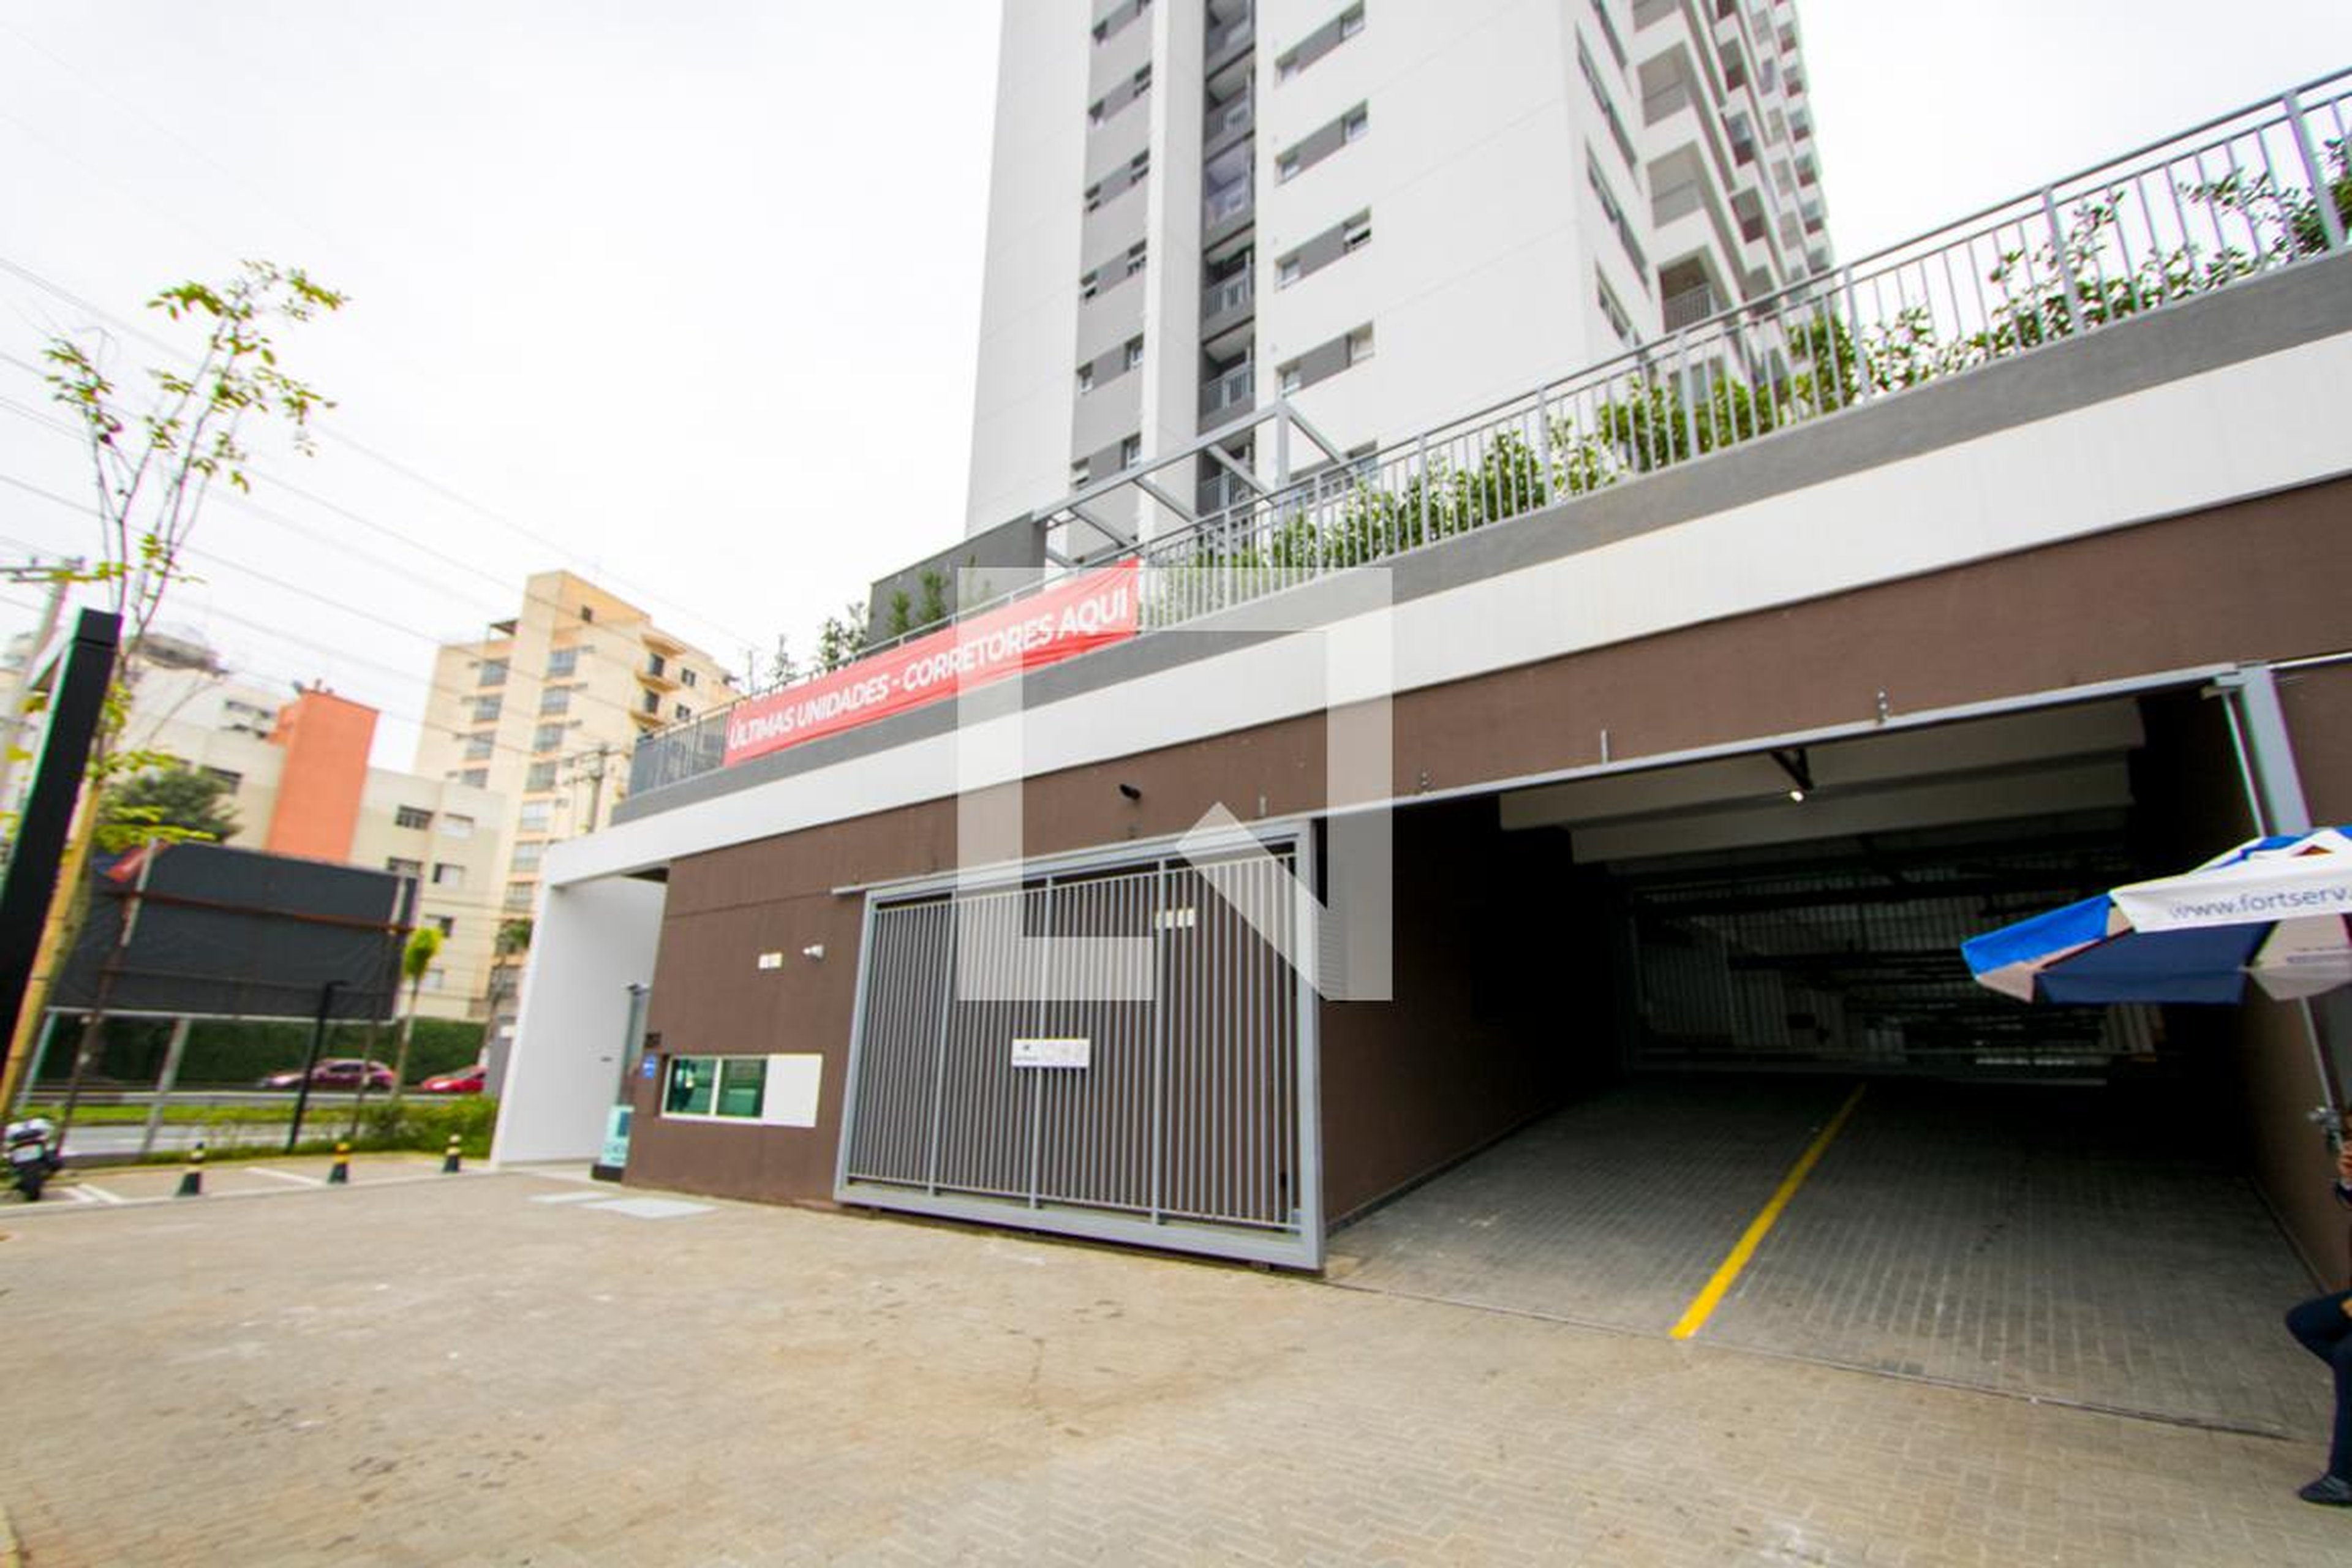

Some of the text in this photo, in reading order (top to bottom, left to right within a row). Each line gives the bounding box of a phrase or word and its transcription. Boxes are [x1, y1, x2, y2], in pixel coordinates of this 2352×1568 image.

[729, 707, 795, 750] ÚLTIMAS
[798, 674, 889, 727] UNIDADES
[903, 614, 1054, 692] CORRETORES
[1057, 587, 1128, 641] AQUI
